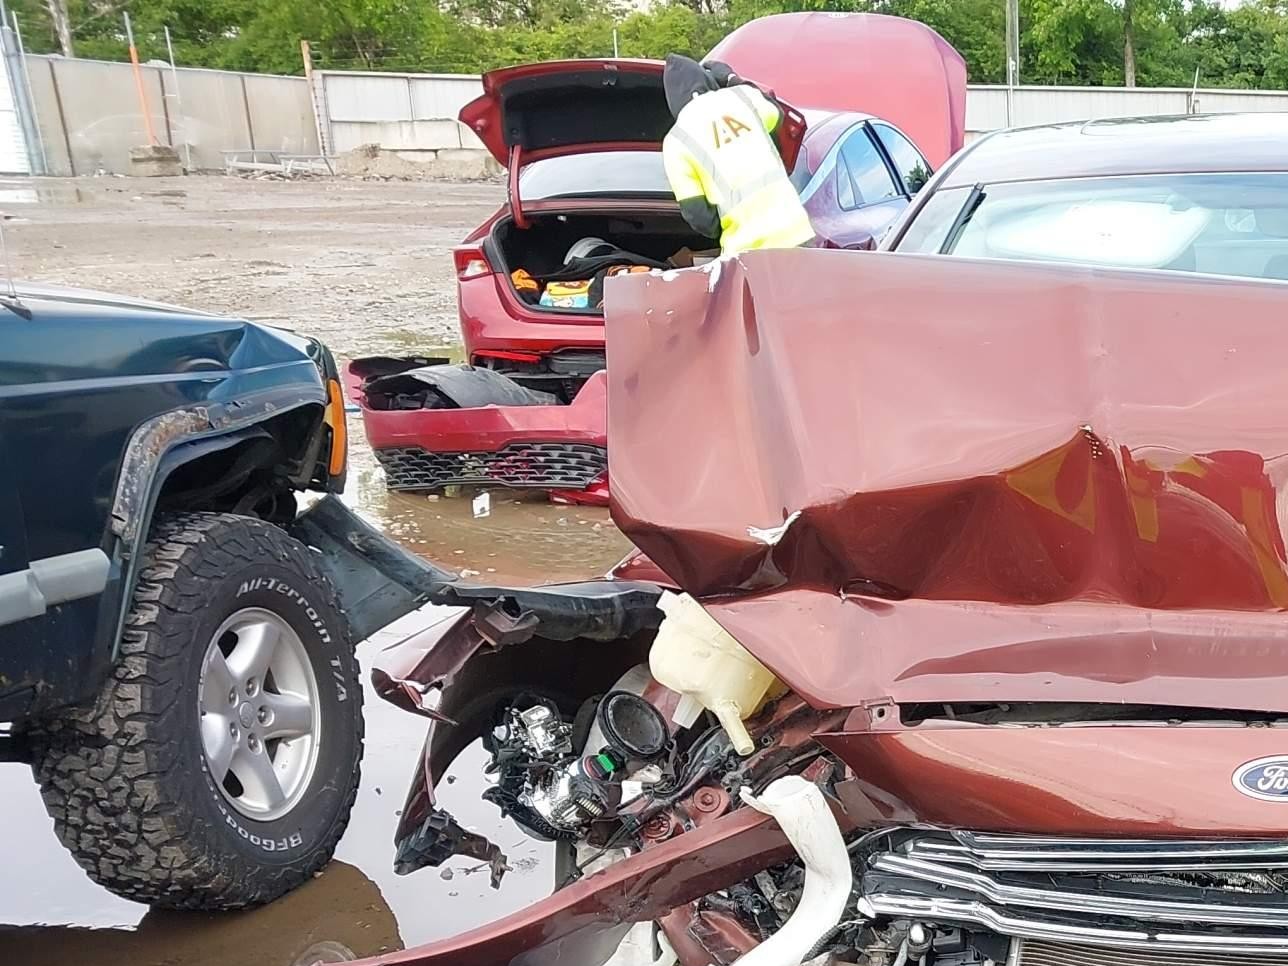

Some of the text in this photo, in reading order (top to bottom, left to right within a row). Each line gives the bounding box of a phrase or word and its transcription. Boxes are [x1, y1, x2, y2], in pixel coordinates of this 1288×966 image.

[712, 115, 751, 149] IA
[236, 577, 347, 702] All-Terrain T/A
